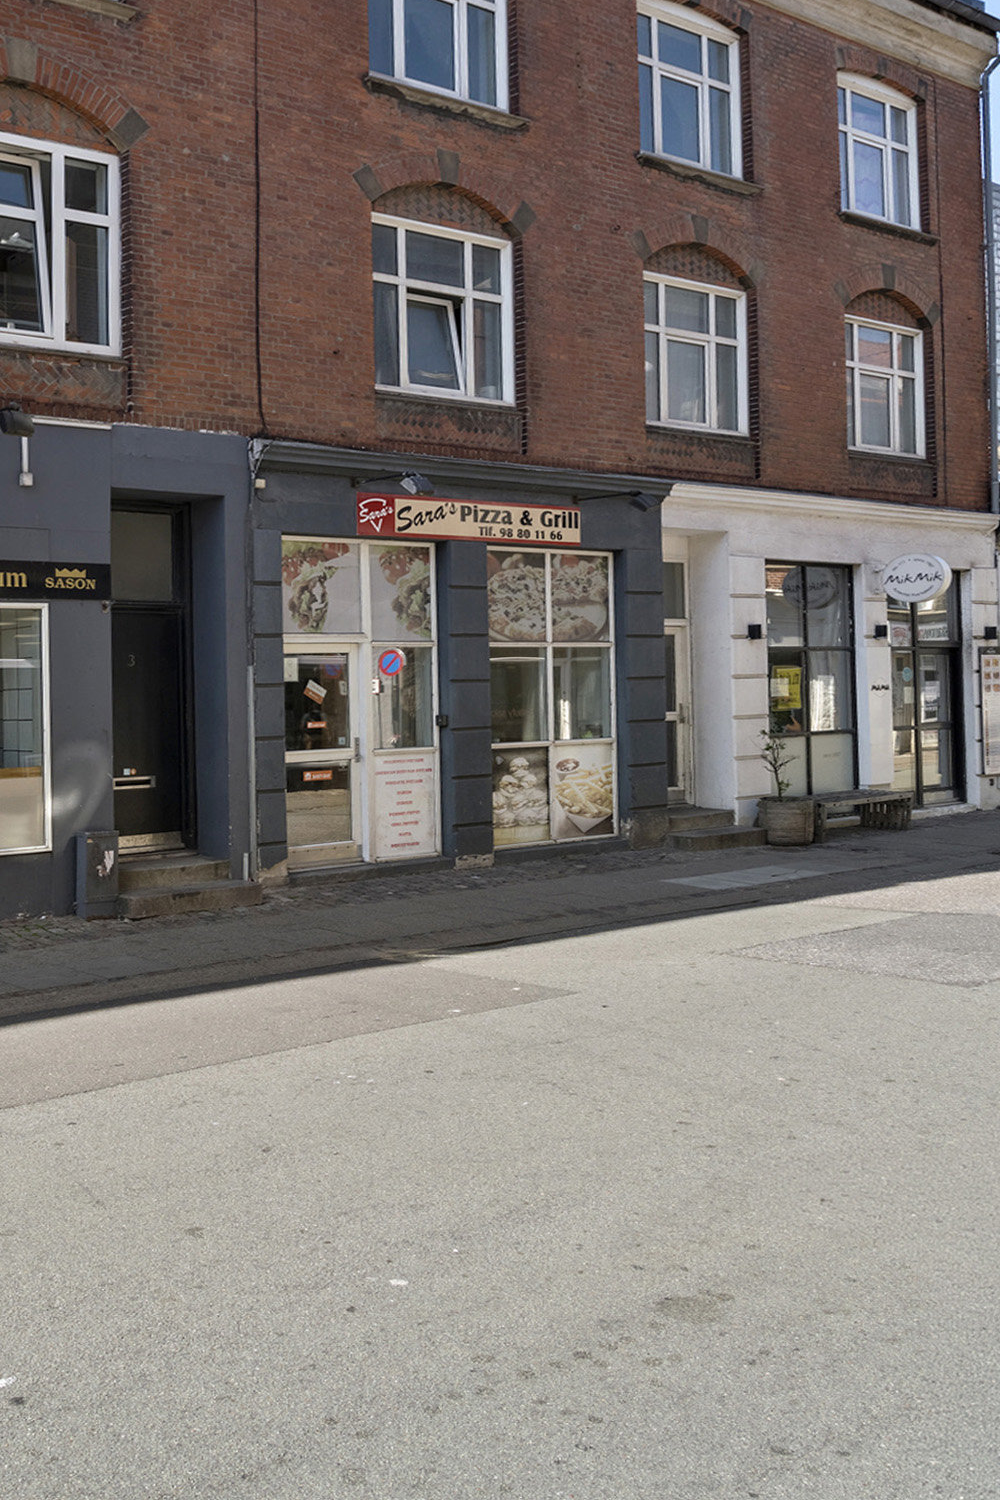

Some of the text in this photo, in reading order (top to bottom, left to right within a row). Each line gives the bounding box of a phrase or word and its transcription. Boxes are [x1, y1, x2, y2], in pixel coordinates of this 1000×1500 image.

[397, 503, 579, 531] Sara's Pizza & Grill
[479, 526, 563, 541] Tlf. 98 80 11 66
[45, 577, 96, 590] SASON
[127, 654, 136, 667] 3
